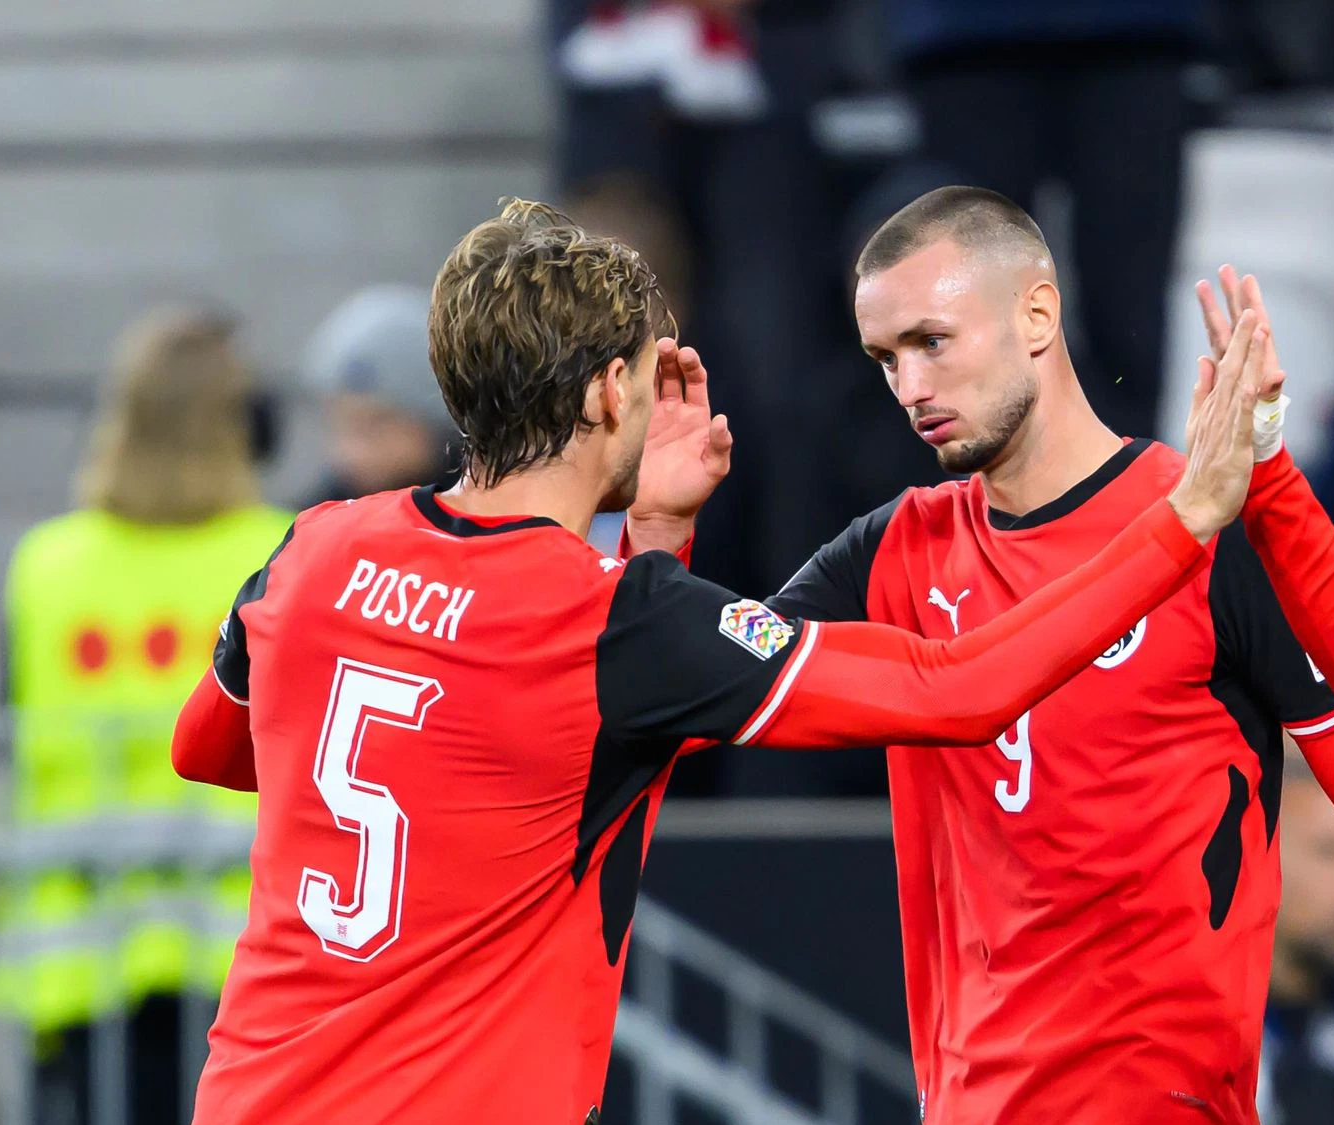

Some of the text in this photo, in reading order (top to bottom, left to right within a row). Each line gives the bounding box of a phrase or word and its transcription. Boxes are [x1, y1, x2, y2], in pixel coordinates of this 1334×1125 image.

[334, 558, 475, 641] POSCH
[297, 656, 444, 962] 5
[994, 709, 1032, 812] 9
